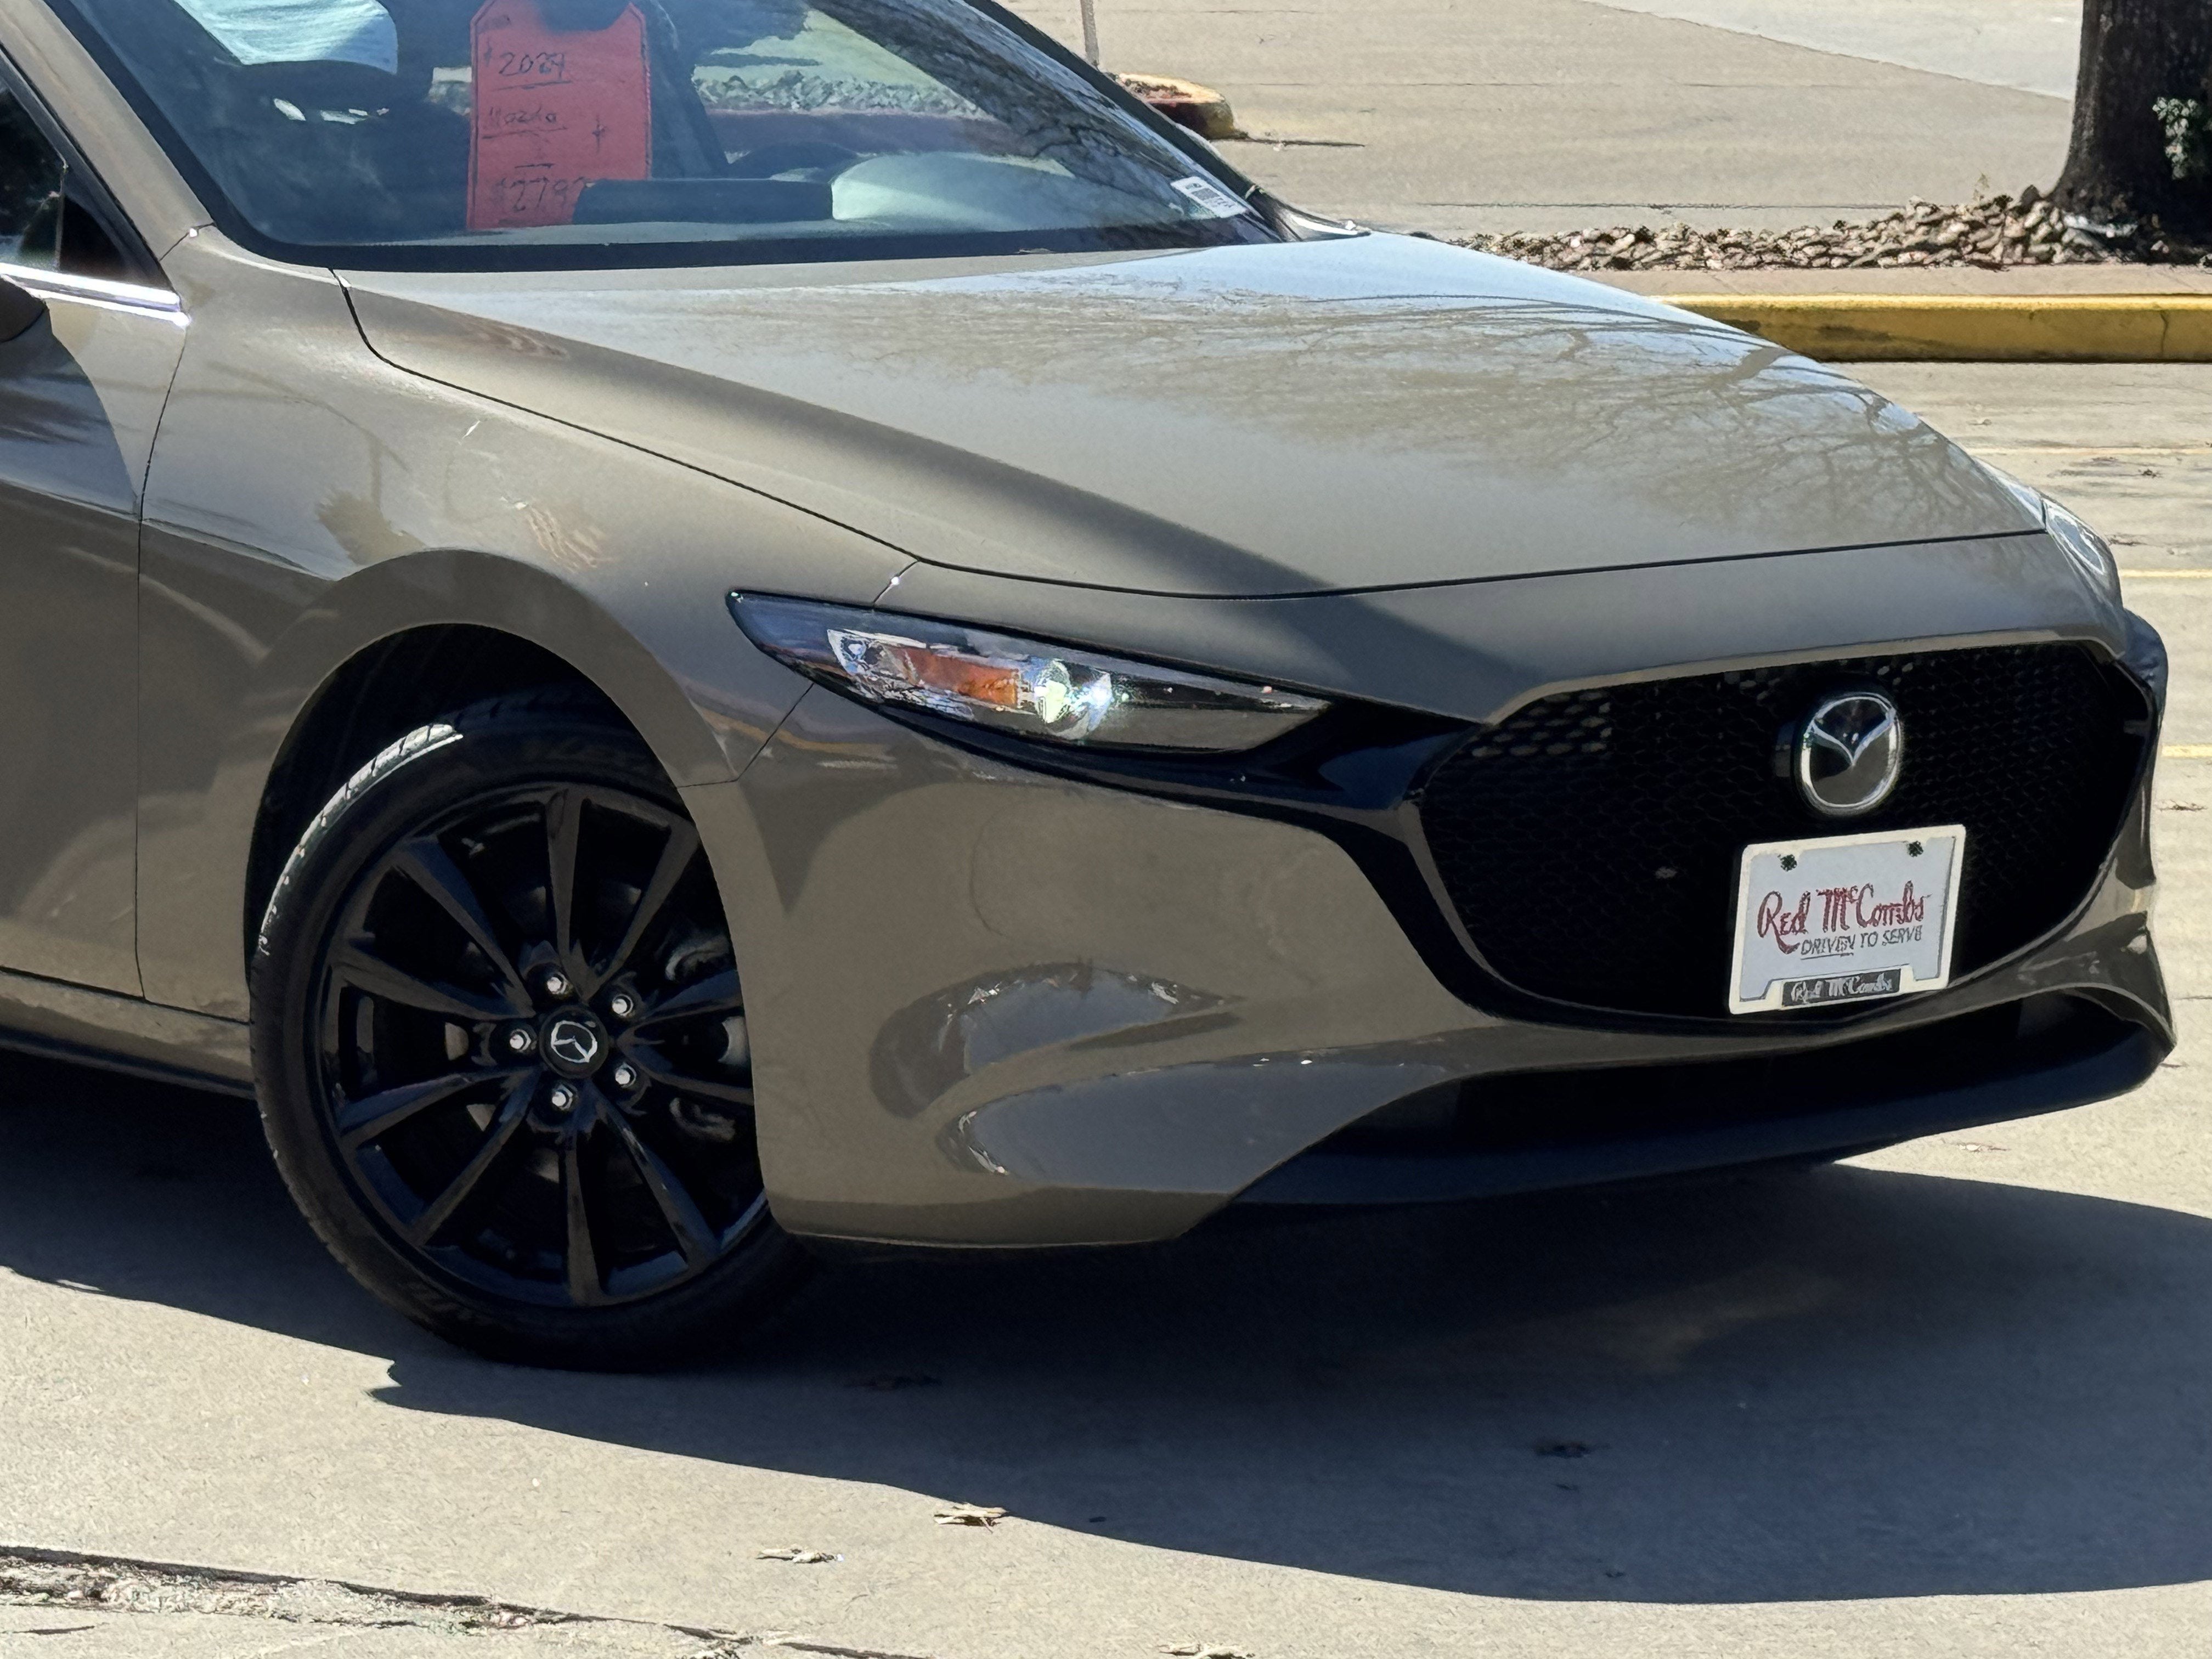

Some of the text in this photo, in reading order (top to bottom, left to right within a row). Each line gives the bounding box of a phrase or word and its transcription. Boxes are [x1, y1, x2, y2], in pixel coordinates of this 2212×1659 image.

[1757, 880, 1932, 955] Red McCombs
[1801, 925, 1923, 956] DRIVEN TO SERVE
